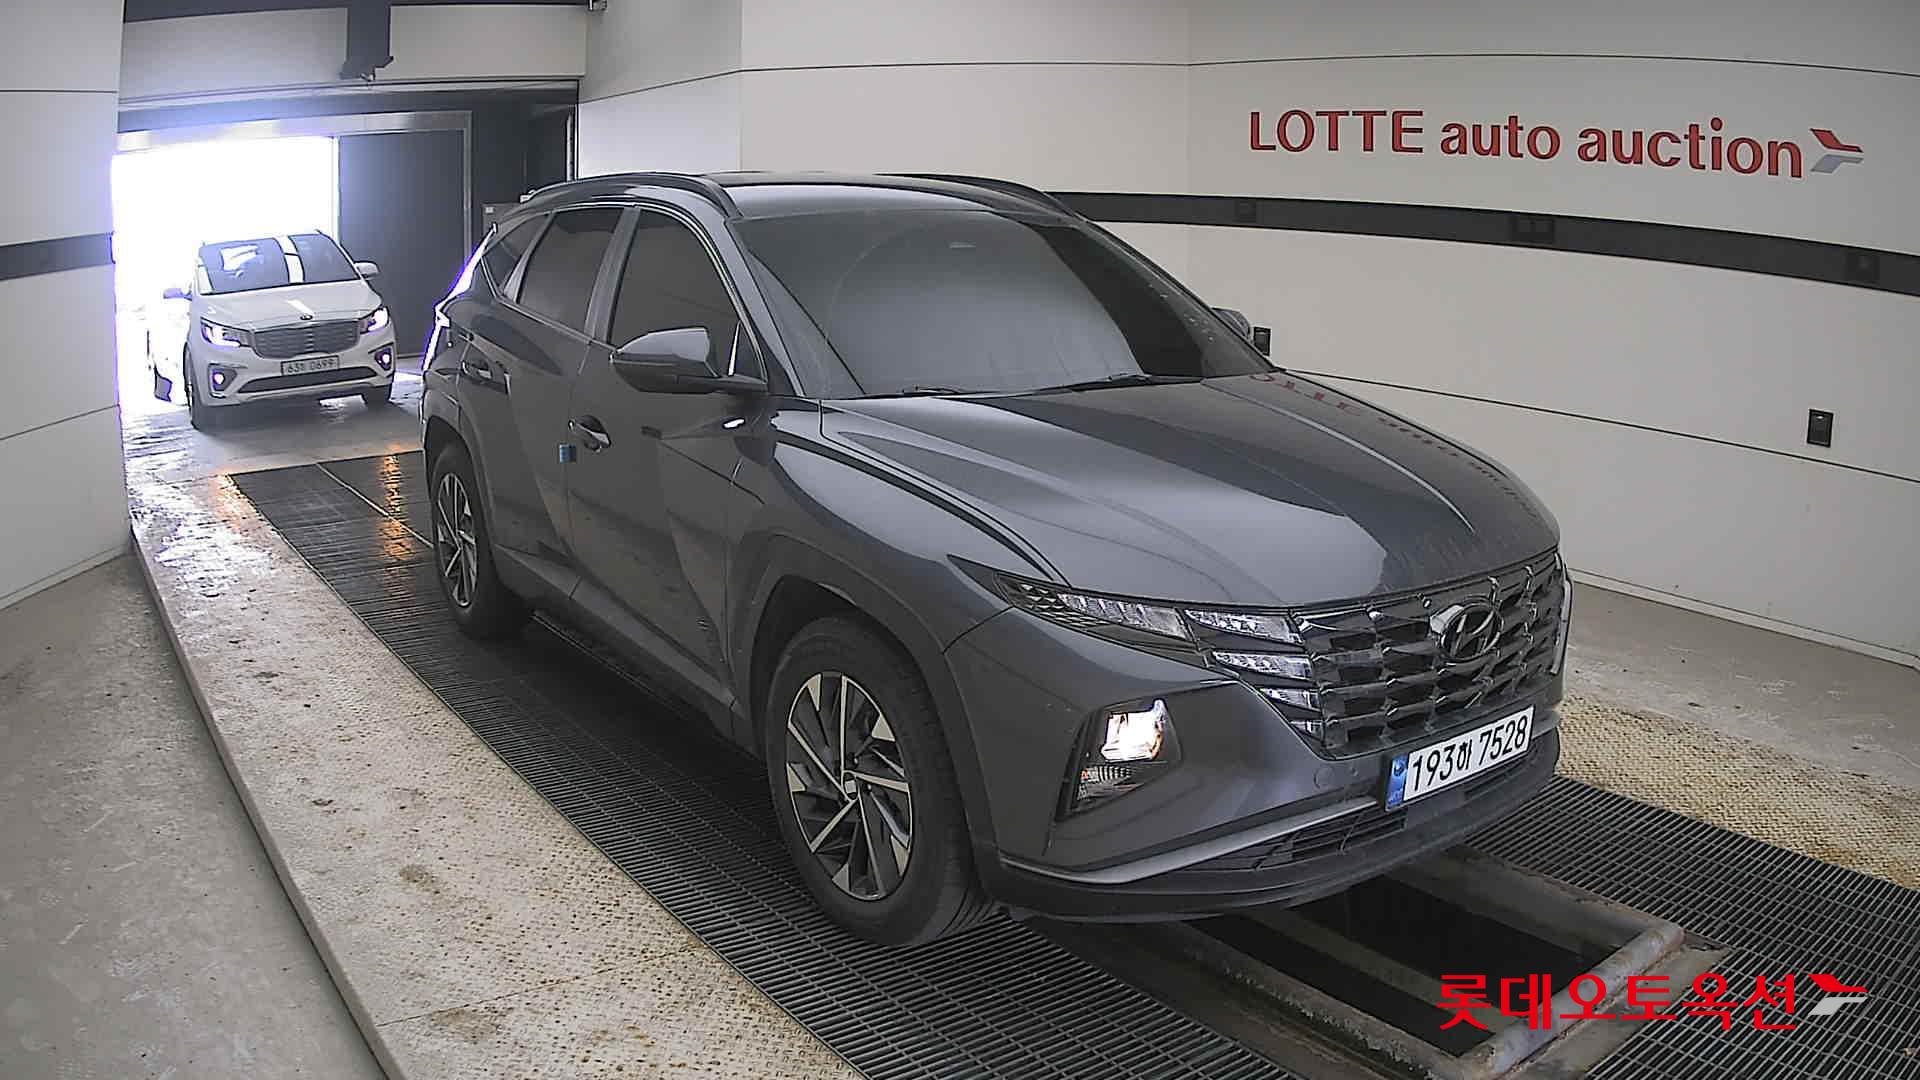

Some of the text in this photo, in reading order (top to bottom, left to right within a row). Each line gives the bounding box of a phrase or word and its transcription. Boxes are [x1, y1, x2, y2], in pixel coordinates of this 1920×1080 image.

[1250, 110, 1802, 178] LOTTE auto auction
[1413, 715, 1528, 791] 193하 7528
